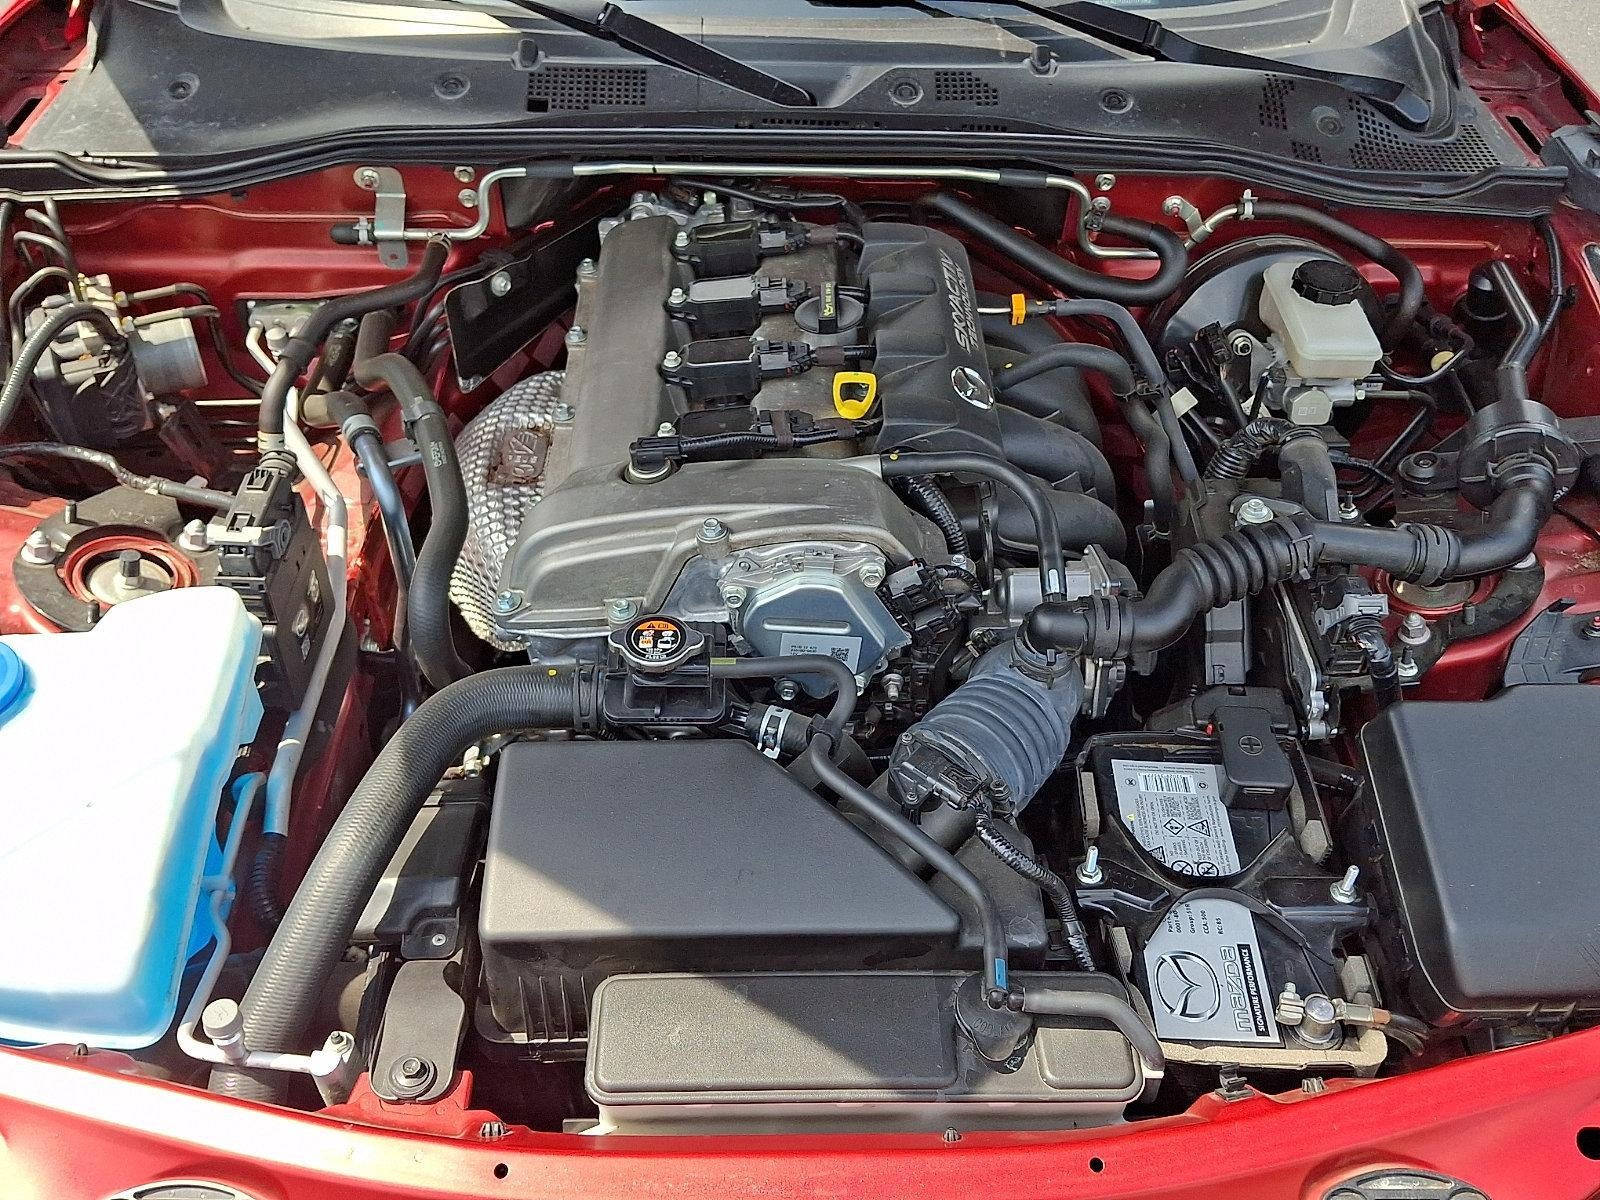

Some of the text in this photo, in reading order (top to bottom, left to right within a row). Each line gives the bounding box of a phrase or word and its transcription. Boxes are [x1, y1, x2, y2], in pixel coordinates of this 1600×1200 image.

[938, 248, 970, 354] SKYACTIV
[955, 262, 978, 348] TECHNOLOGY
[1242, 949, 1265, 1031] SIGNATURE PERFORMANCE
